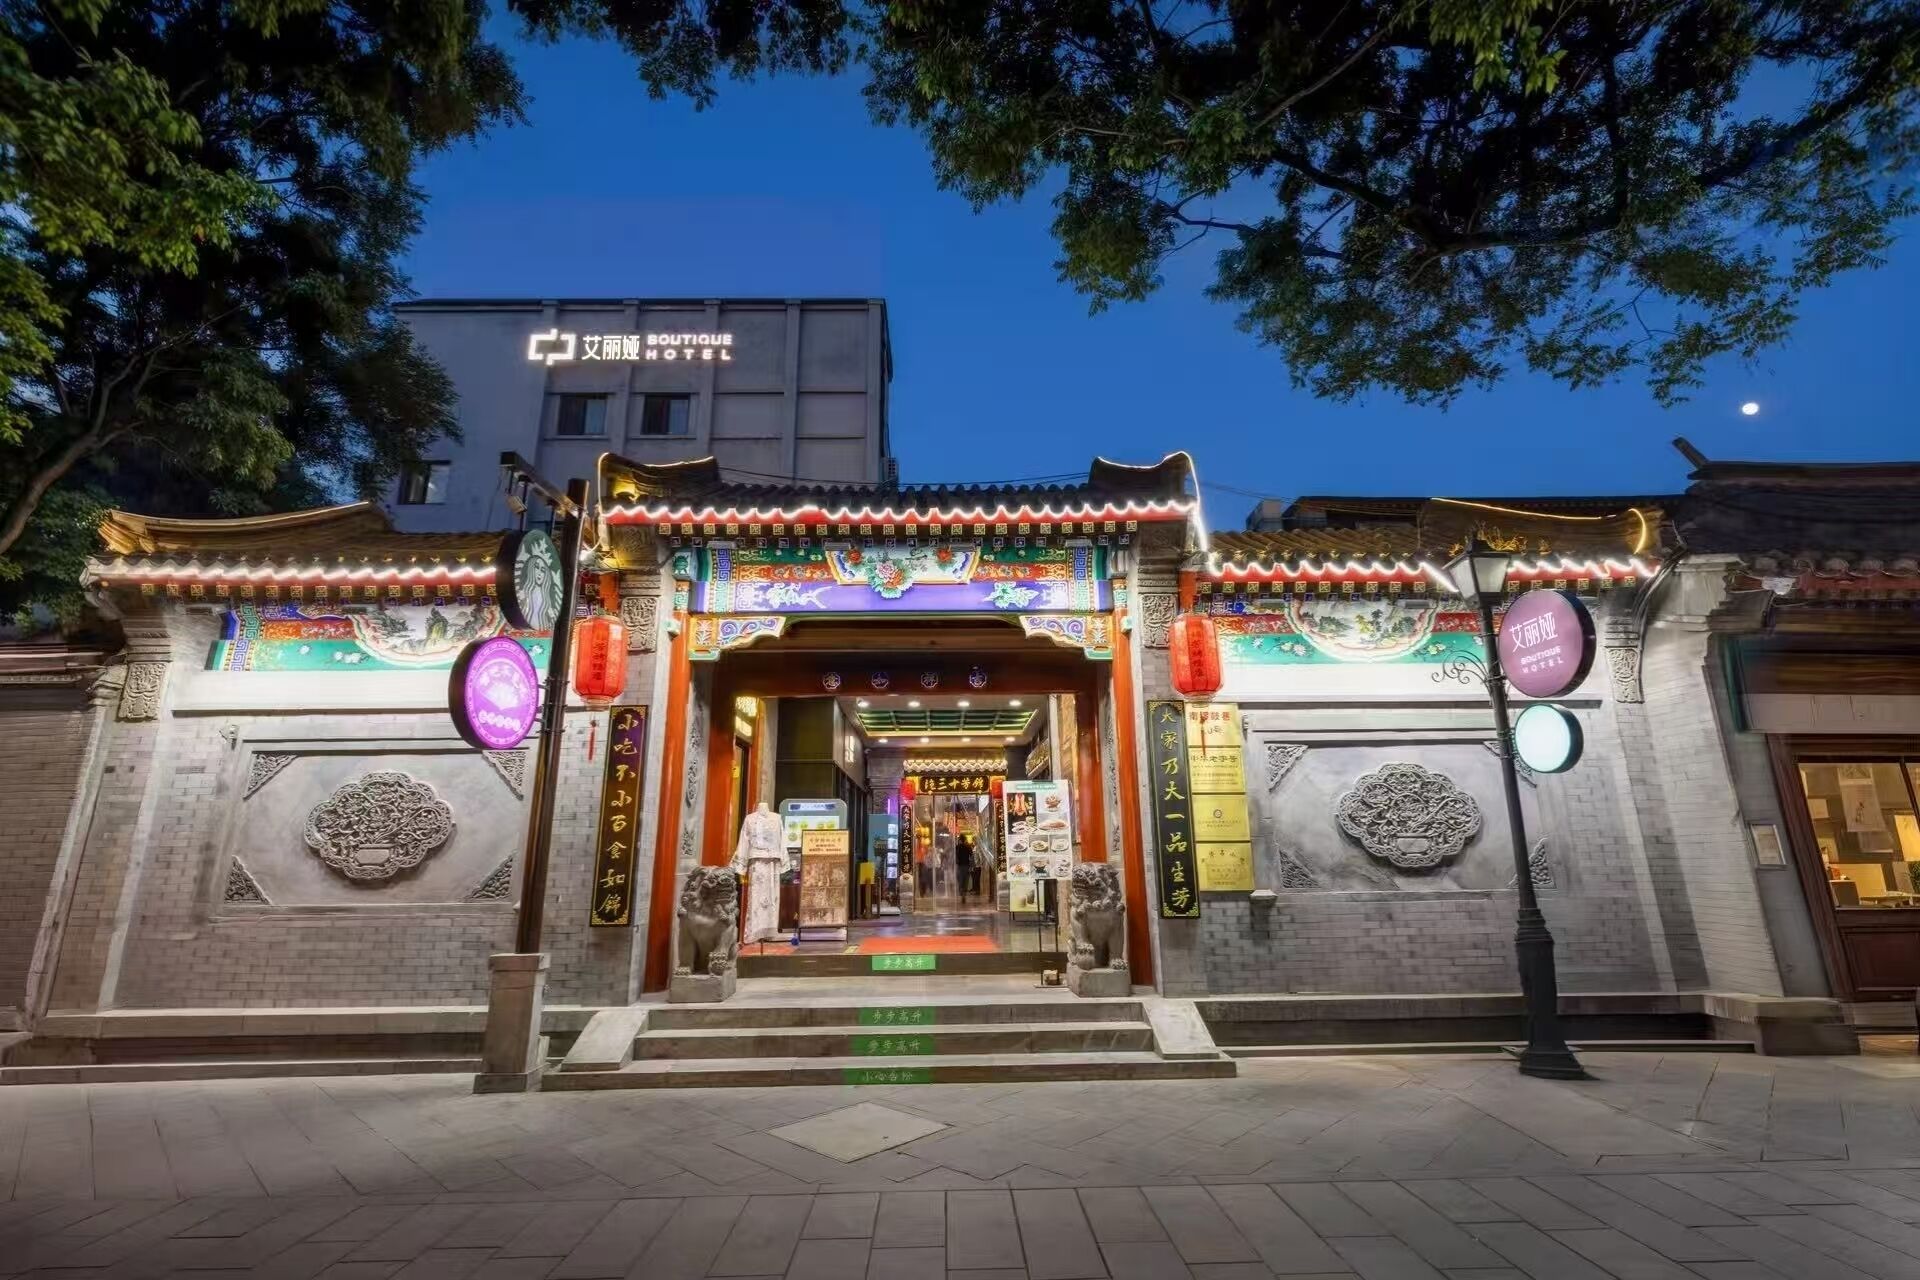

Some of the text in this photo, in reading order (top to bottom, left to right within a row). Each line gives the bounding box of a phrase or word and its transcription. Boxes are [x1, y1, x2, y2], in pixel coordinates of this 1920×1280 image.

[582, 335, 640, 361] 艾丽娅
[646, 334, 732, 346] BOUTIQUE
[646, 349, 732, 361] HOTEL
[1509, 611, 1558, 653] 艾丽娅
[1520, 646, 1561, 665] BOUTIQUE
[1522, 657, 1563, 674] HOTEL
[1160, 706, 1191, 909] 大家乃大一品生芳
[872, 1009, 922, 1024] 步步高升
